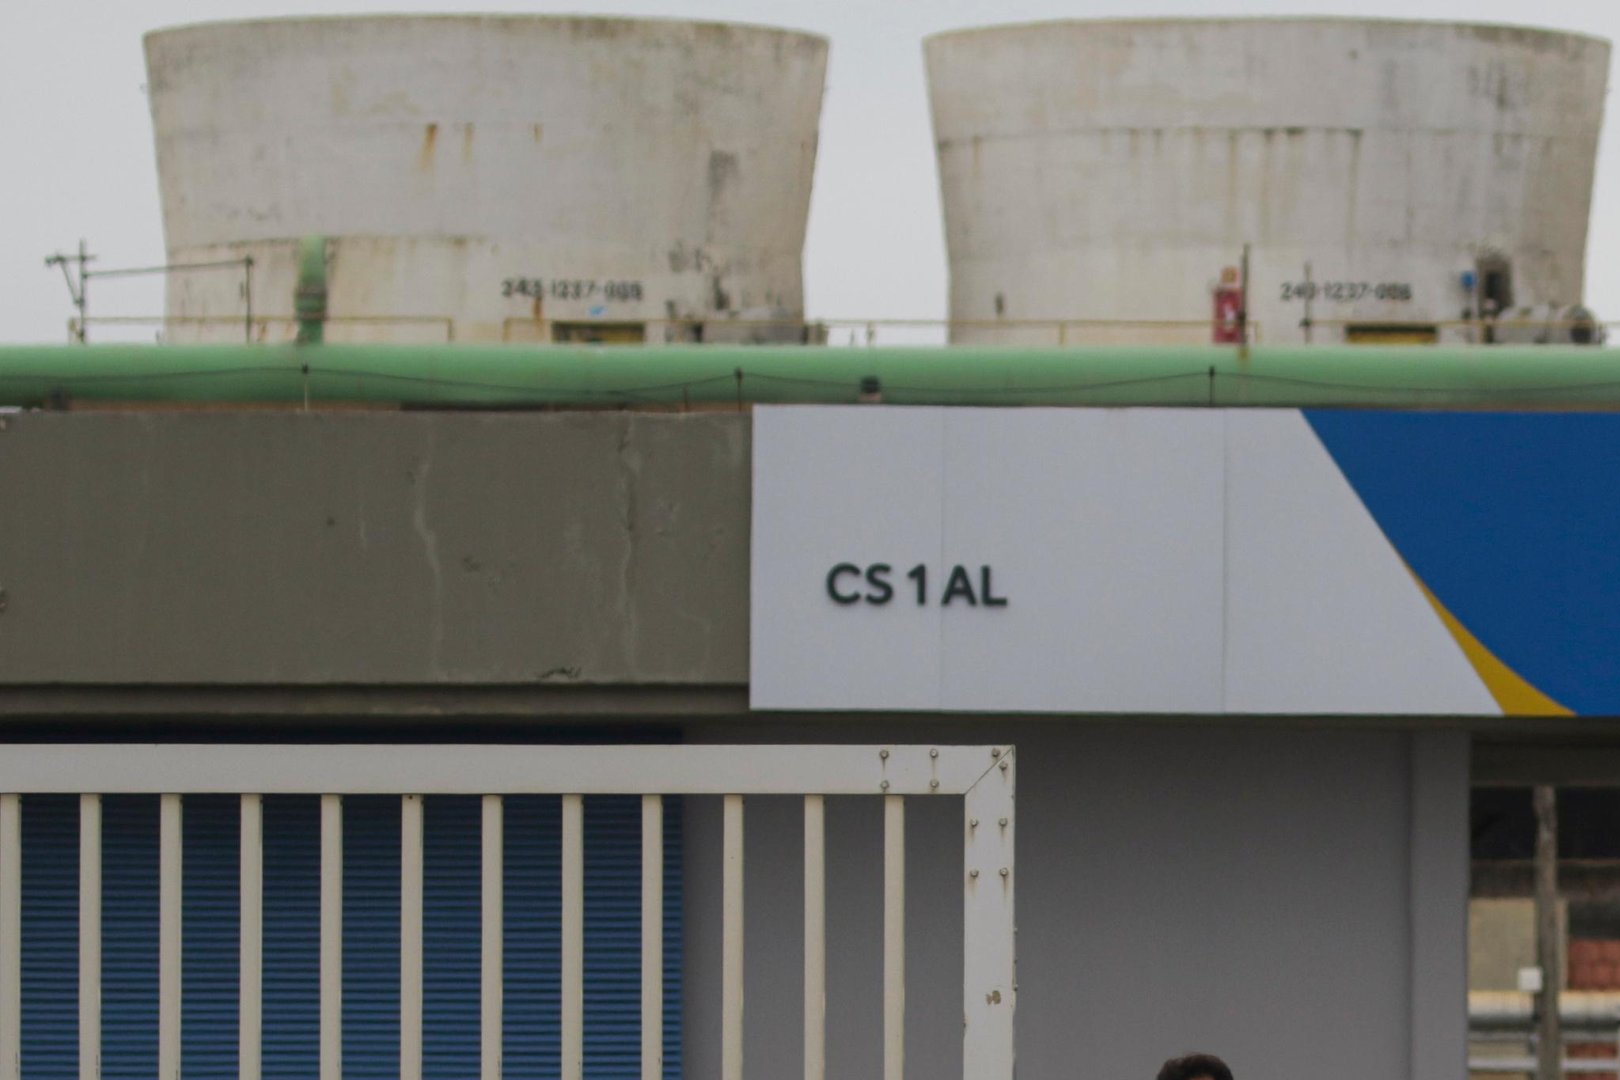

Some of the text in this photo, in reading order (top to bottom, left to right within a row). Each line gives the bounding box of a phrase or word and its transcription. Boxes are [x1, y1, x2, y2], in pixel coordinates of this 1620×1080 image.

[826, 562, 1009, 608] CS 1 AL
